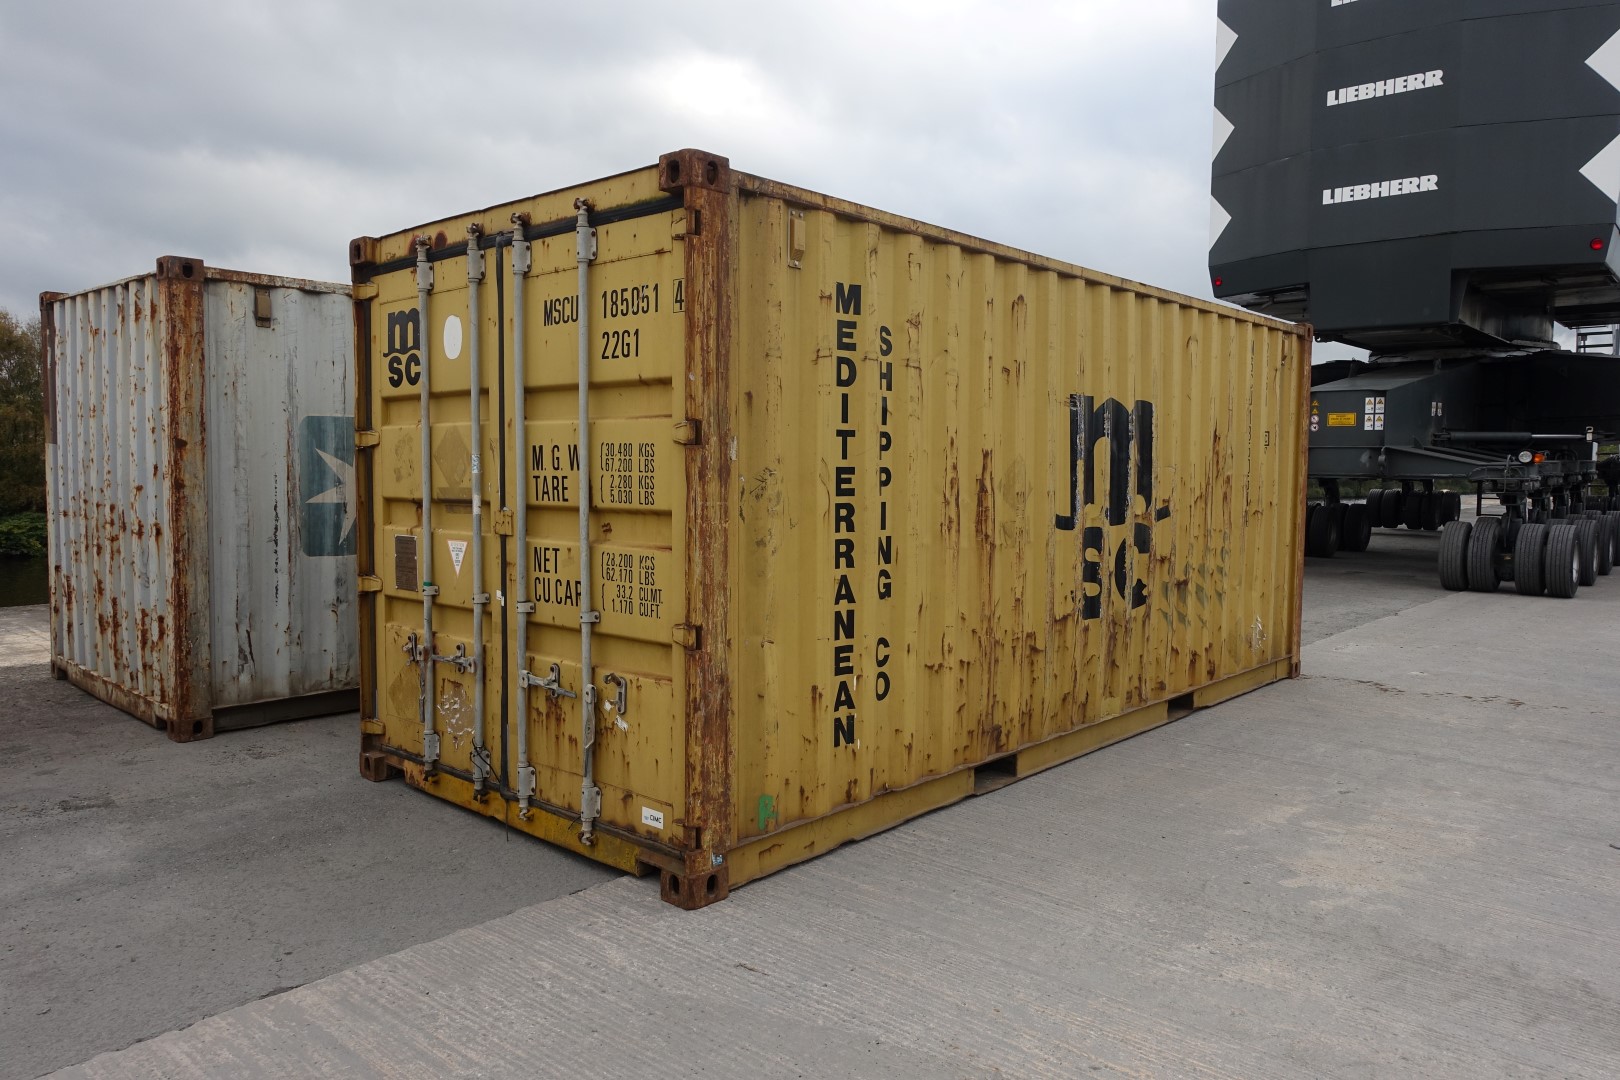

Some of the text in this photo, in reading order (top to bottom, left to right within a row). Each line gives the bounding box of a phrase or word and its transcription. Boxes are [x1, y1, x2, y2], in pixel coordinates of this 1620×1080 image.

[1327, 69, 1444, 107] LIEBHERR
[1322, 174, 1439, 205] LIEBHERR
[543, 280, 685, 327] MSCU 185051 4
[601, 328, 640, 360] 22G1
[638, 442, 655, 458] KGS
[877, 325, 893, 601] SHIPPING
[638, 458, 655, 473] LBS
[532, 475, 569, 502] TARE
[638, 474, 655, 490] KGS
[638, 490, 655, 505] LBS
[834, 281, 862, 748] MEDITERRANEAN
[533, 546, 560, 574] NET
[639, 555, 656, 571] KGS
[639, 570, 656, 586] LBS
[616, 584, 633, 600] 33.2
[875, 636, 891, 702] CO
